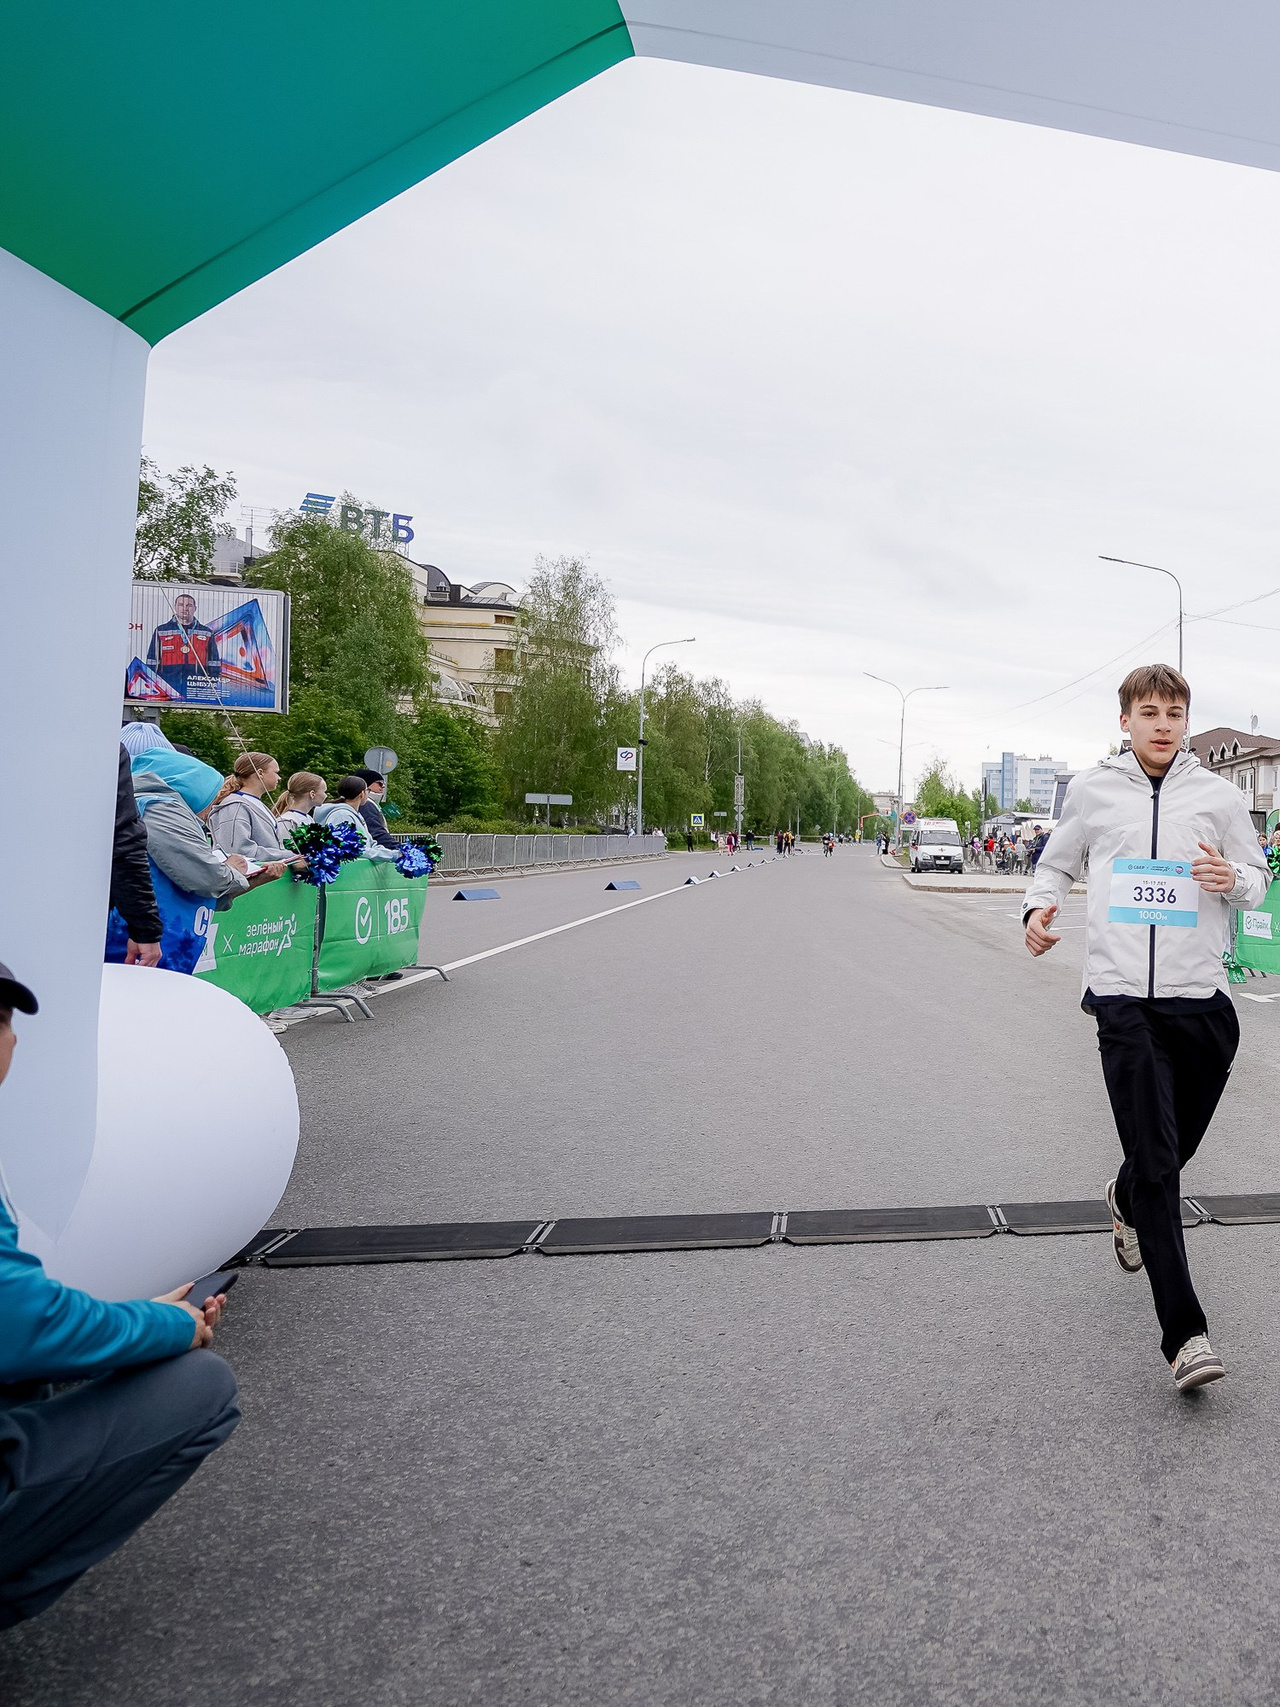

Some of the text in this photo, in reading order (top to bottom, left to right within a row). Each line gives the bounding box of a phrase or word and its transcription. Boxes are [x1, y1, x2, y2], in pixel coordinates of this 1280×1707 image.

[341, 505, 415, 543] ВТБ
[1133, 886, 1177, 904] 3336
[246, 916, 284, 937] зелёный
[384, 898, 408, 935] 185
[239, 936, 279, 957] марафон
